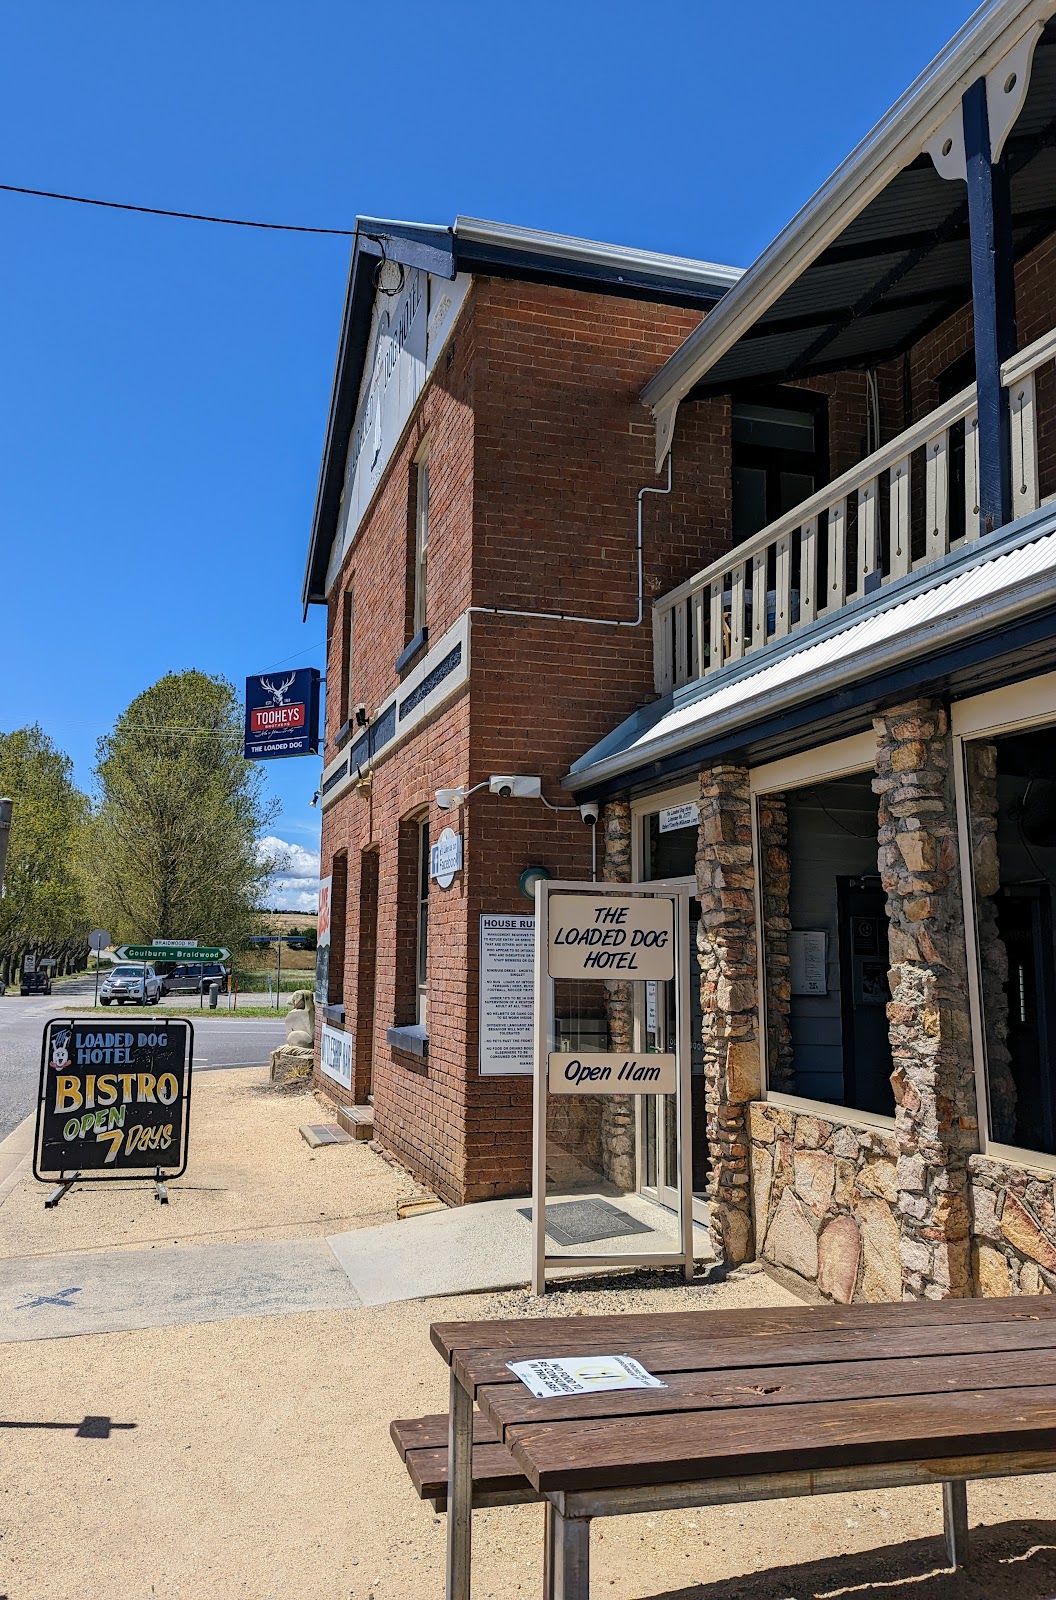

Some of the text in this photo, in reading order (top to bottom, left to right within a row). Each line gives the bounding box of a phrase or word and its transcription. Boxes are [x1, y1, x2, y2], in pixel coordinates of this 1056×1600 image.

[256, 707, 300, 725] TOOHEYS
[264, 743, 288, 752] LOADED
[289, 741, 303, 749] DOG
[484, 920, 517, 928] HOUSE
[595, 907, 630, 924] THE
[554, 927, 669, 948] LOADED DOG
[177, 950, 219, 958] Braidwood
[583, 951, 638, 970] HOTEL
[75, 1033, 168, 1049] LOADED DOG
[76, 1048, 135, 1065] HOTEL
[564, 1059, 661, 1086] Open 11am
[54, 1072, 179, 1114] BISTRO
[63, 1104, 126, 1142] OPEN
[96, 1128, 124, 1163] 7
[533, 1369, 550, 1380] THIS
[542, 1380, 562, 1392] AREA
[544, 1367, 575, 1392] CONSUMED
[557, 1371, 576, 1383] FOOD
